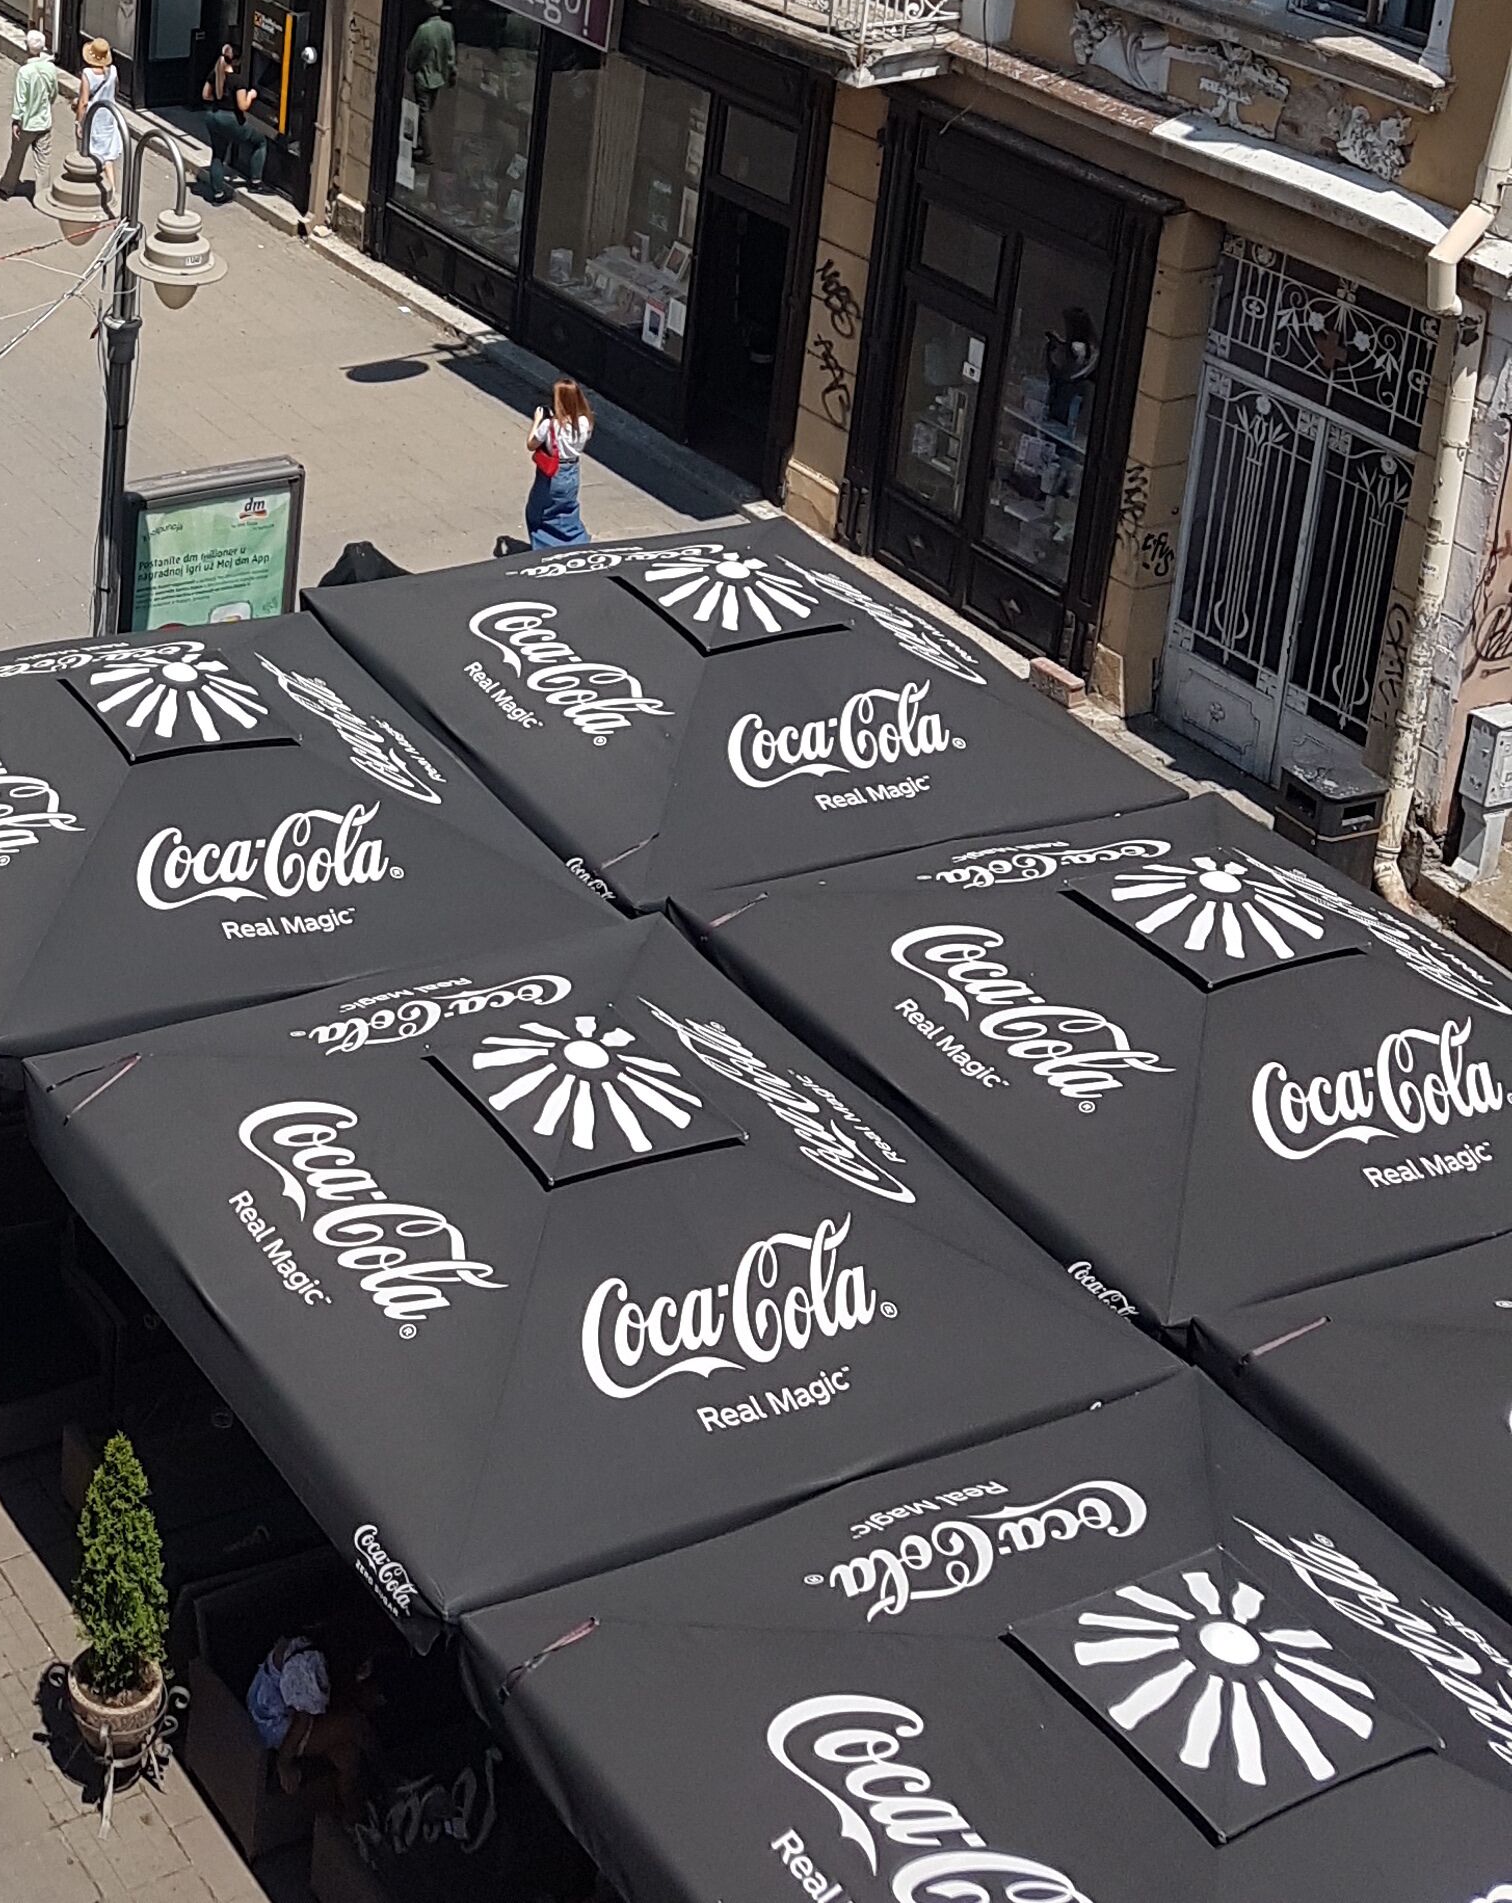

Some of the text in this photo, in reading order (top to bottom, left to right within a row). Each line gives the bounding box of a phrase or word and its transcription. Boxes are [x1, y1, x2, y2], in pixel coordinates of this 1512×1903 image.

[244, 497, 266, 512] dm
[252, 553, 271, 565] App
[463, 661, 544, 729] Real Magic
[468, 601, 675, 737] Coca-Cola
[727, 679, 953, 789] Coca-Cola
[815, 775, 932, 811] Real Magic
[136, 800, 390, 911] Coca-Cola
[222, 906, 358, 942] Real Magic
[309, 973, 574, 1057] Coca-Cola
[890, 924, 1177, 1101] Coca-Cola
[894, 998, 1011, 1090] Real Magic
[1251, 1016, 1504, 1162] Coca-Cola
[237, 1100, 510, 1322] Coca-Cola
[1362, 1140, 1494, 1192] Real Magic
[227, 1189, 333, 1307] Real Magic
[581, 1212, 878, 1400] Coca-Cola
[697, 1365, 851, 1434] Real Magic
[354, 1524, 418, 1609] Coca-Cola
[828, 1479, 1147, 1623] Coca-Cola
